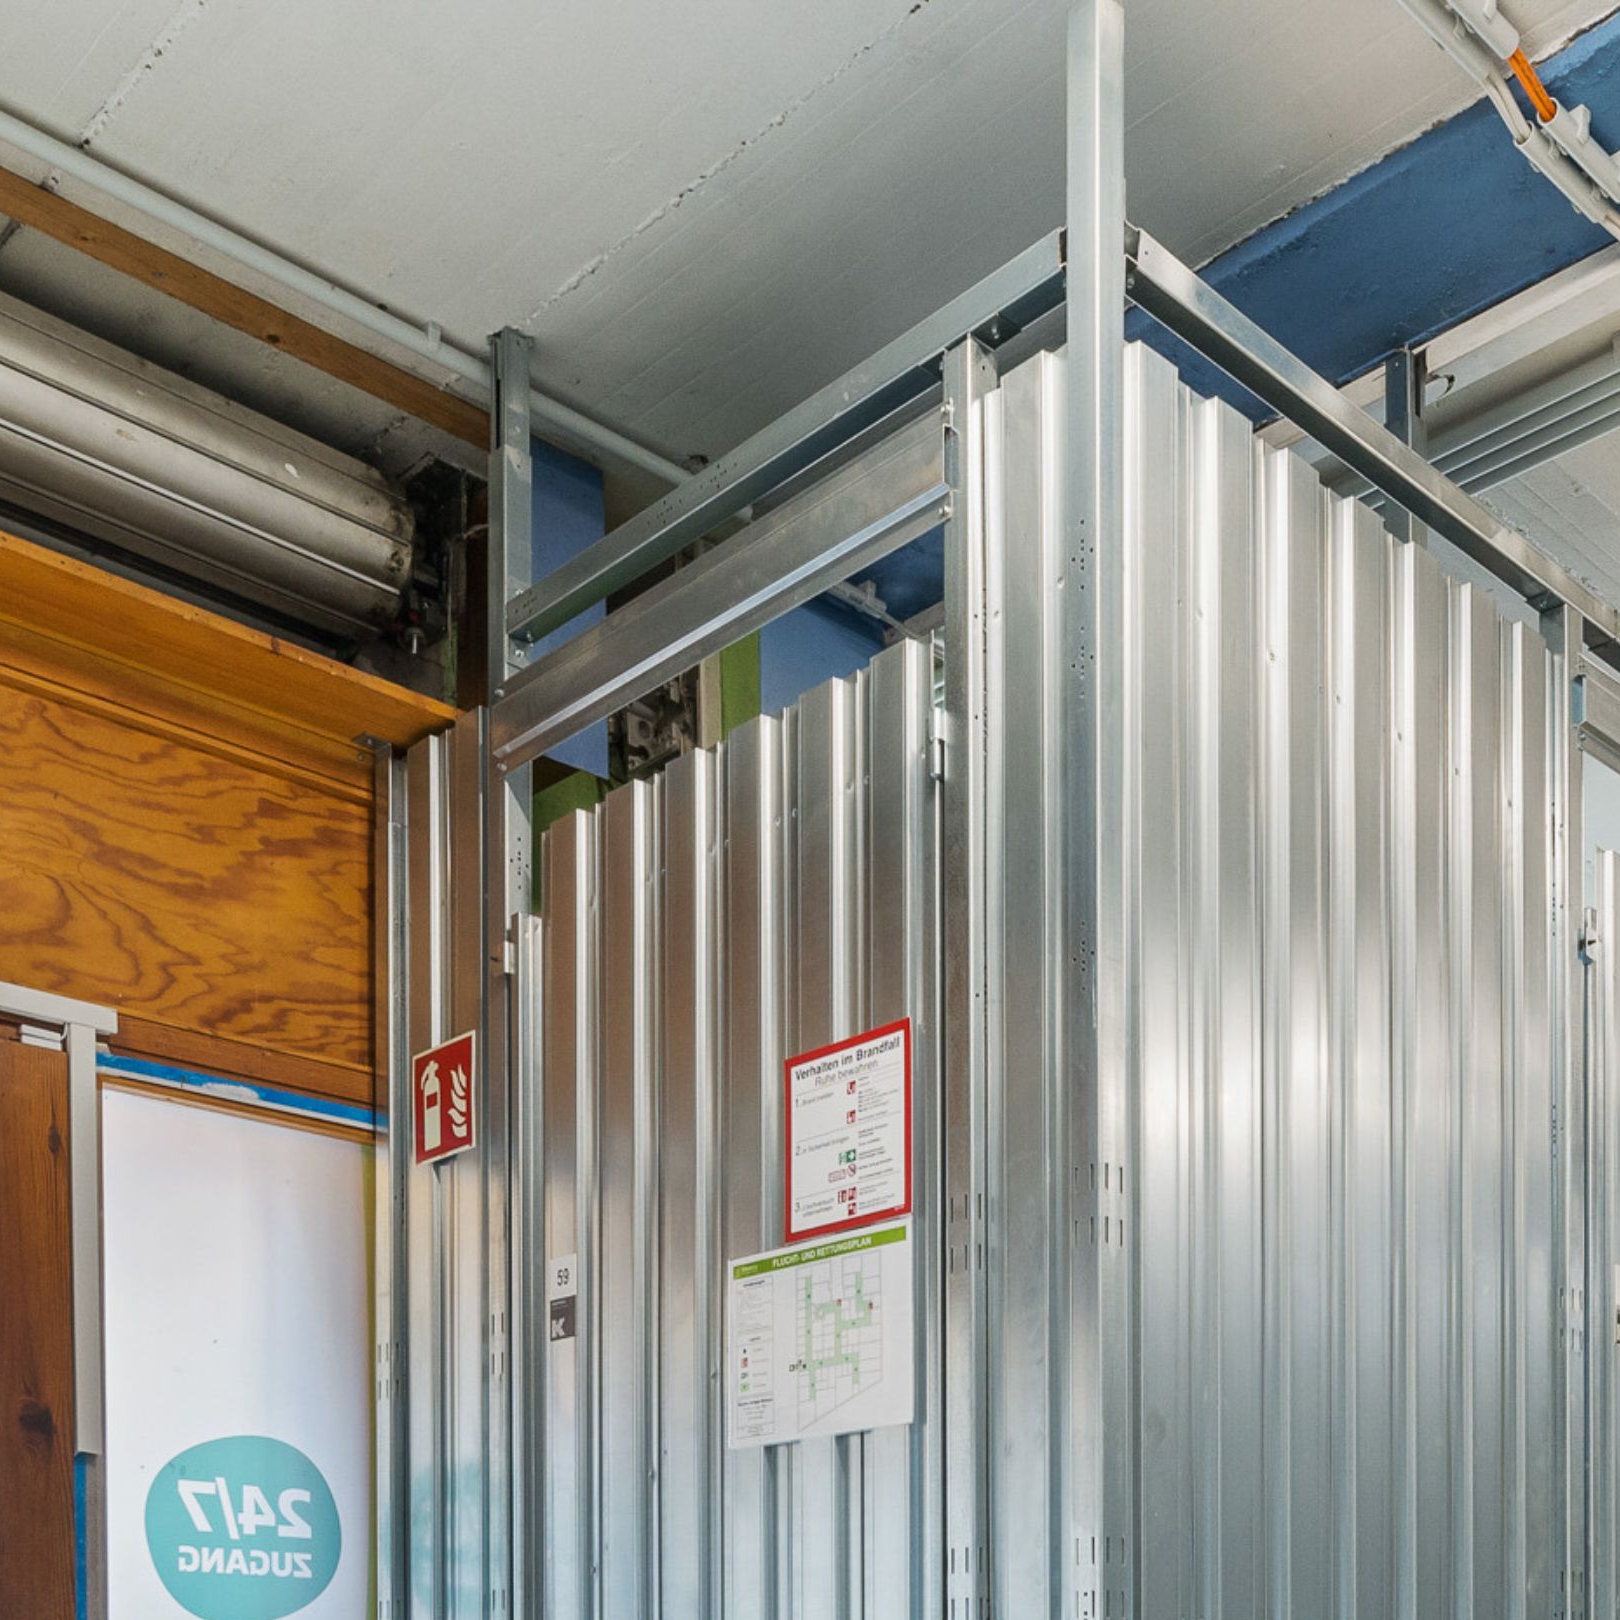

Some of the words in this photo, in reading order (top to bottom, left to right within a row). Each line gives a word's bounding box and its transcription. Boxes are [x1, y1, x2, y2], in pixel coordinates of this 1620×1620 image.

[795, 1059, 838, 1080] Verhalten
[841, 1054, 853, 1066] im
[856, 1036, 900, 1061] Brandfall
[814, 1073, 837, 1087] Ruhe
[837, 1060, 878, 1079] bewahren
[557, 1268, 569, 1286] 59
